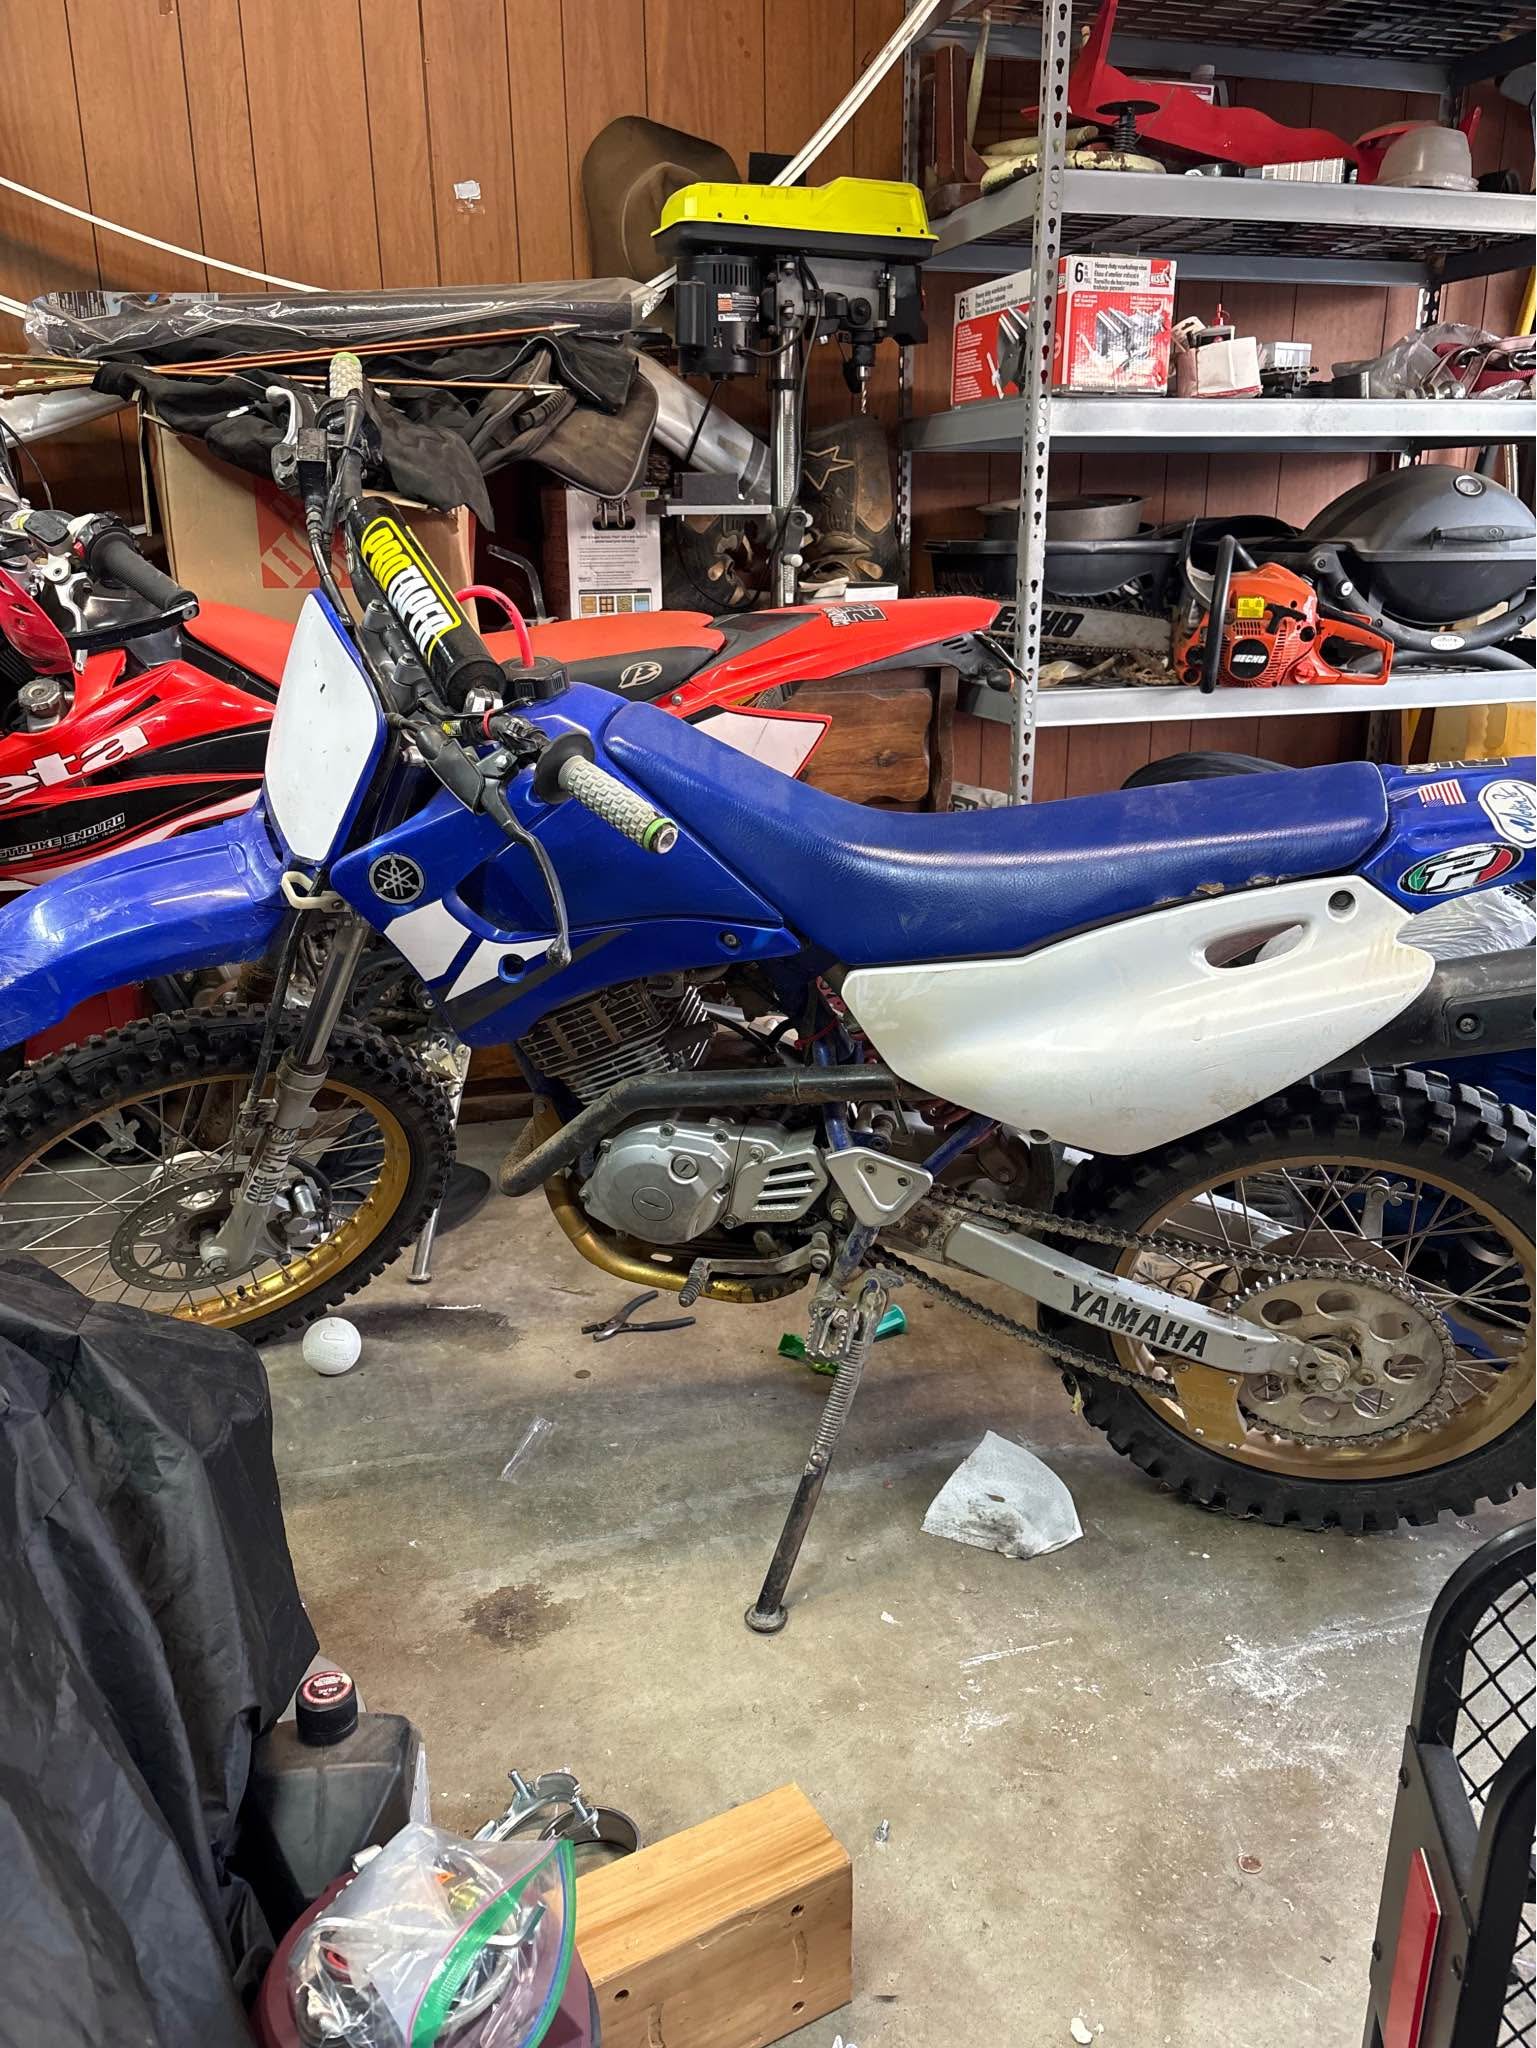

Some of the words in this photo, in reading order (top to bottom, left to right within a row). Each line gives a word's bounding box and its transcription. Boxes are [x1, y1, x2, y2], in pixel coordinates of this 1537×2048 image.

[1074, 262, 1084, 283] 6
[958, 297, 966, 320] 6
[991, 606, 1085, 638] EHO
[63, 812, 126, 845] ENDURO
[1069, 1284, 1209, 1358] YAMAHA
